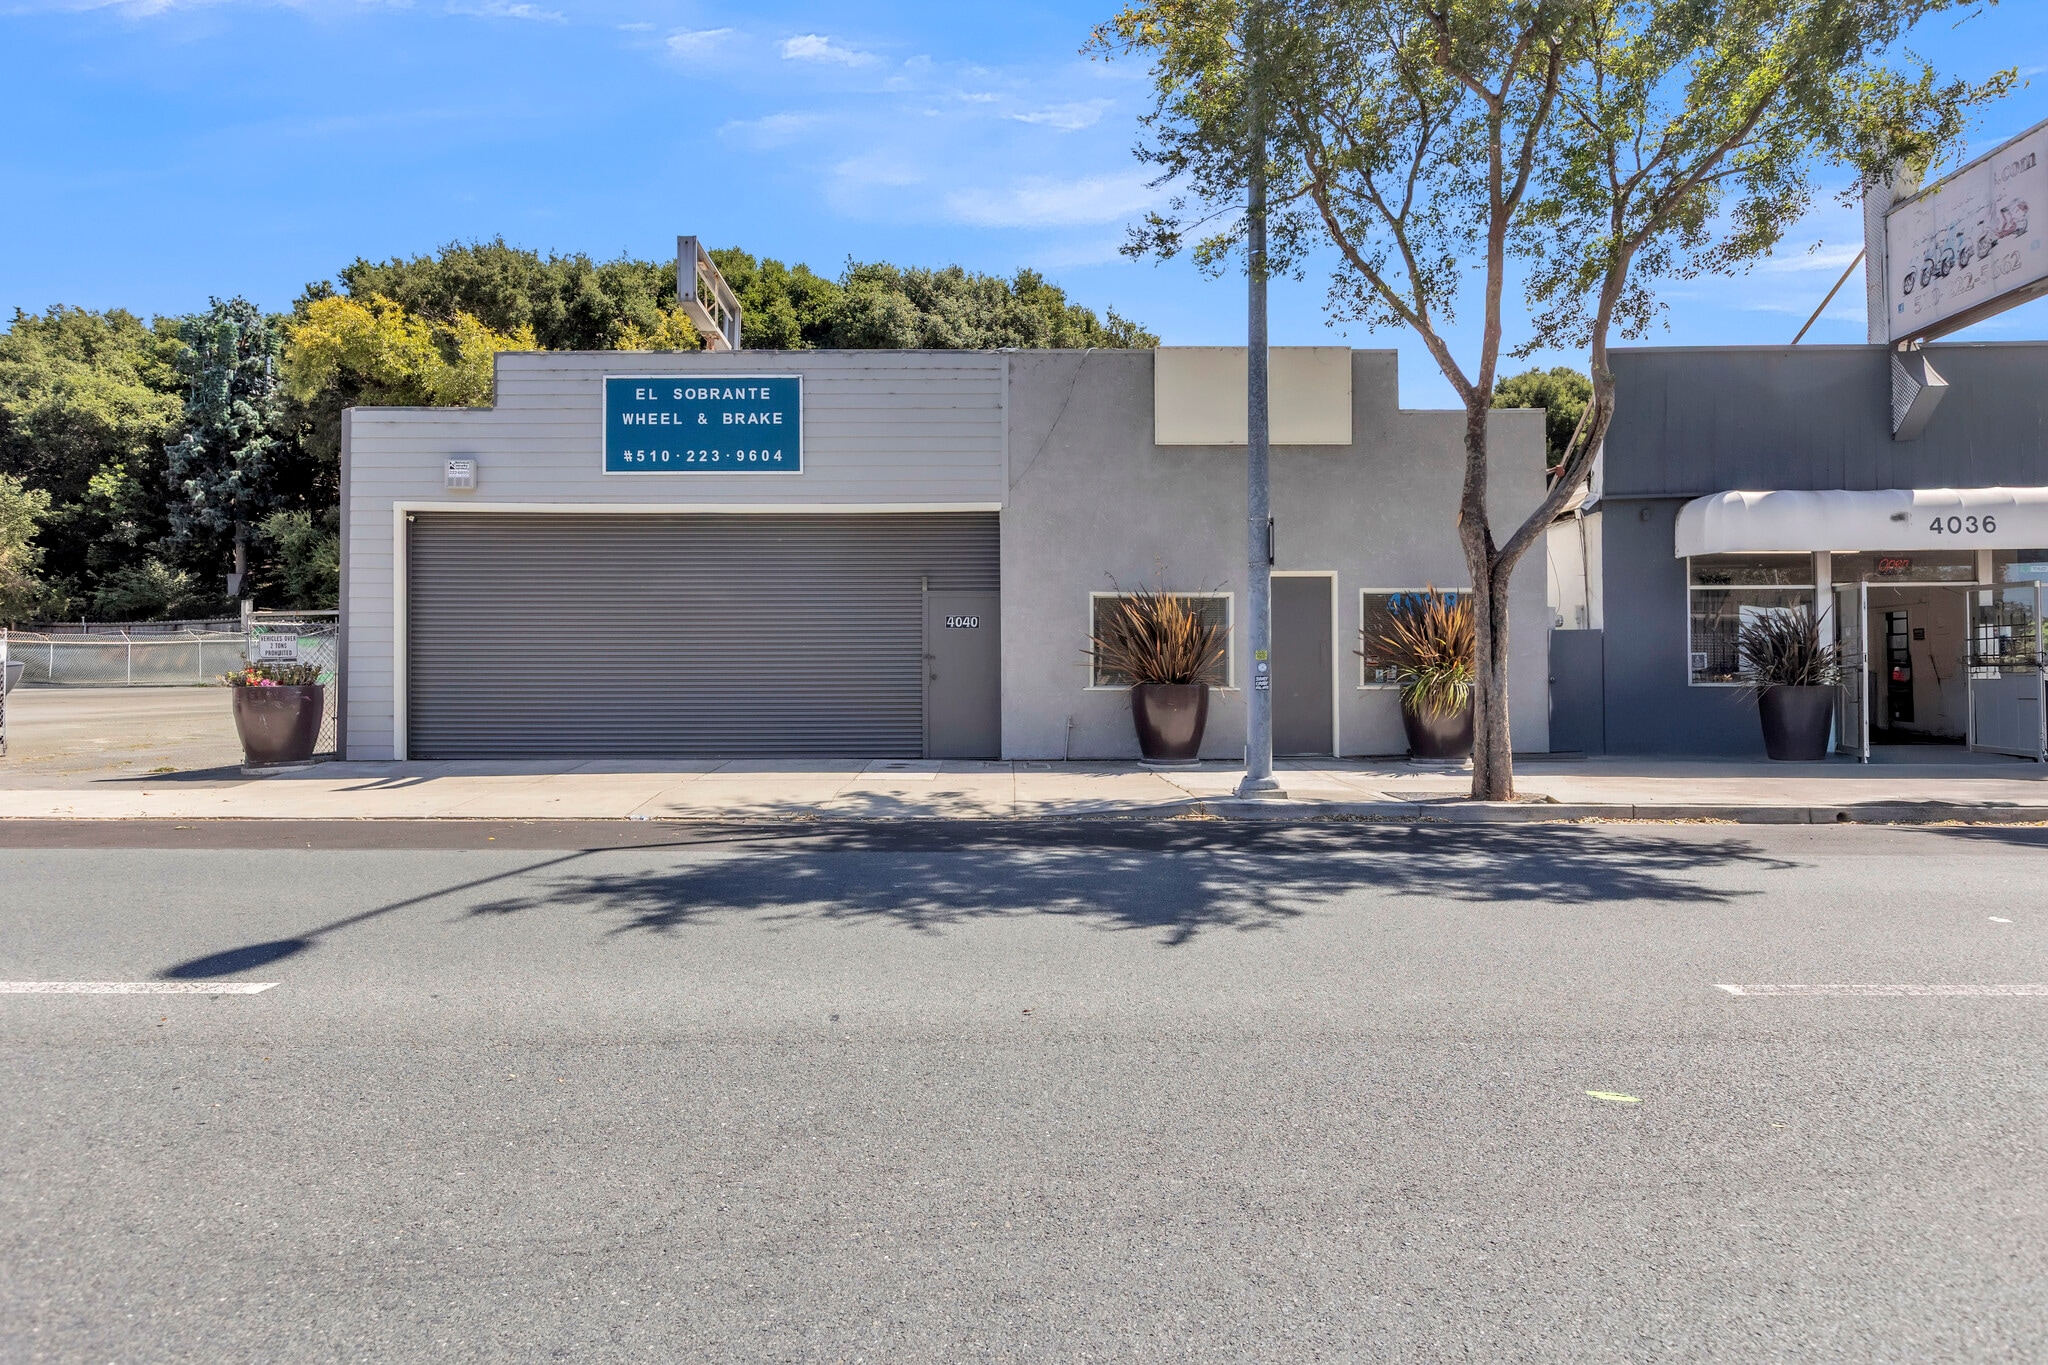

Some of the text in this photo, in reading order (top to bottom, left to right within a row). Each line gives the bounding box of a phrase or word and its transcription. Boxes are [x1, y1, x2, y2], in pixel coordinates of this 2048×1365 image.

[635, 387, 771, 400] EL SOBRANTE
[622, 412, 783, 425] WHEEL & BRAKE
[1929, 515, 1997, 535] 4036
[946, 616, 978, 628] 4040
